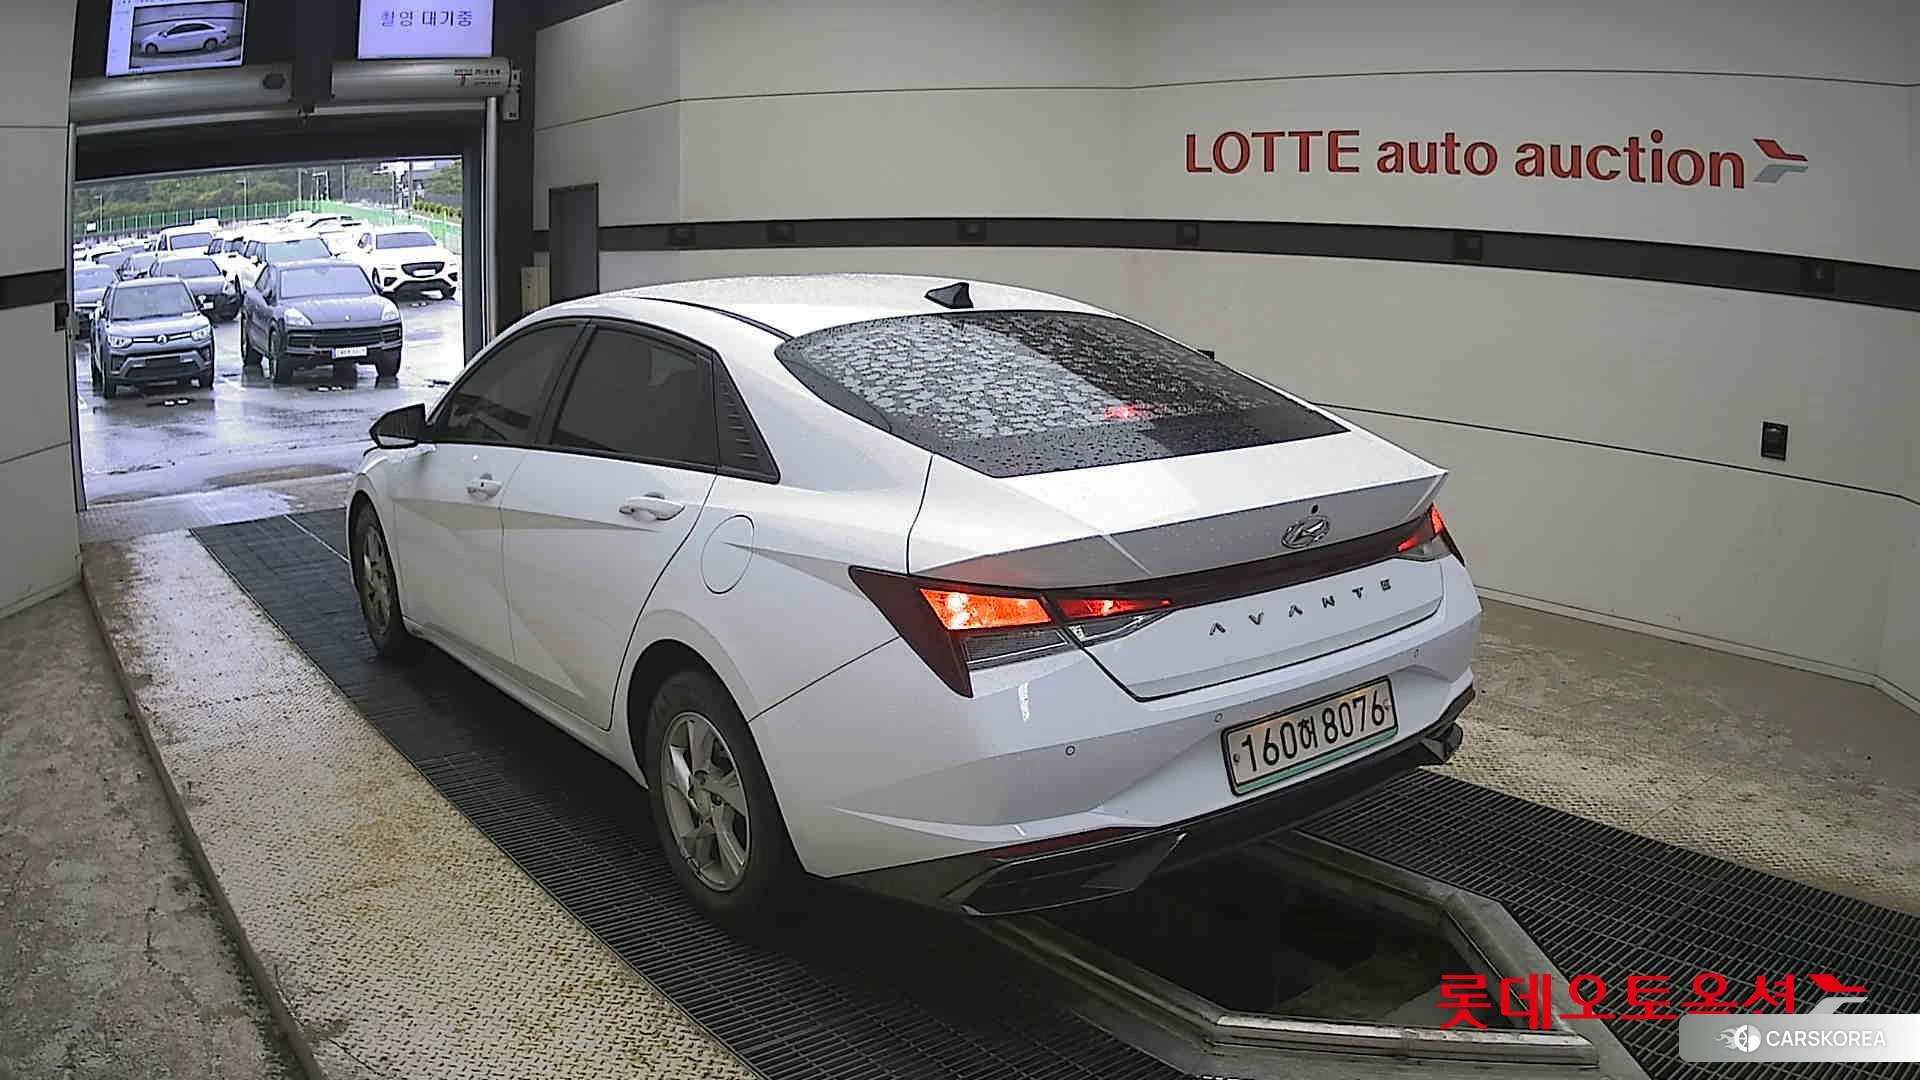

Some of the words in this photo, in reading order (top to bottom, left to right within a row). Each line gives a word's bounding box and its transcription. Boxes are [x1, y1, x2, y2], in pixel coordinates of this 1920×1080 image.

[1186, 130, 1360, 175] LOTTE
[1376, 132, 1498, 177] auto
[1514, 128, 1745, 189] auction
[1209, 578, 1392, 636] AVANTE
